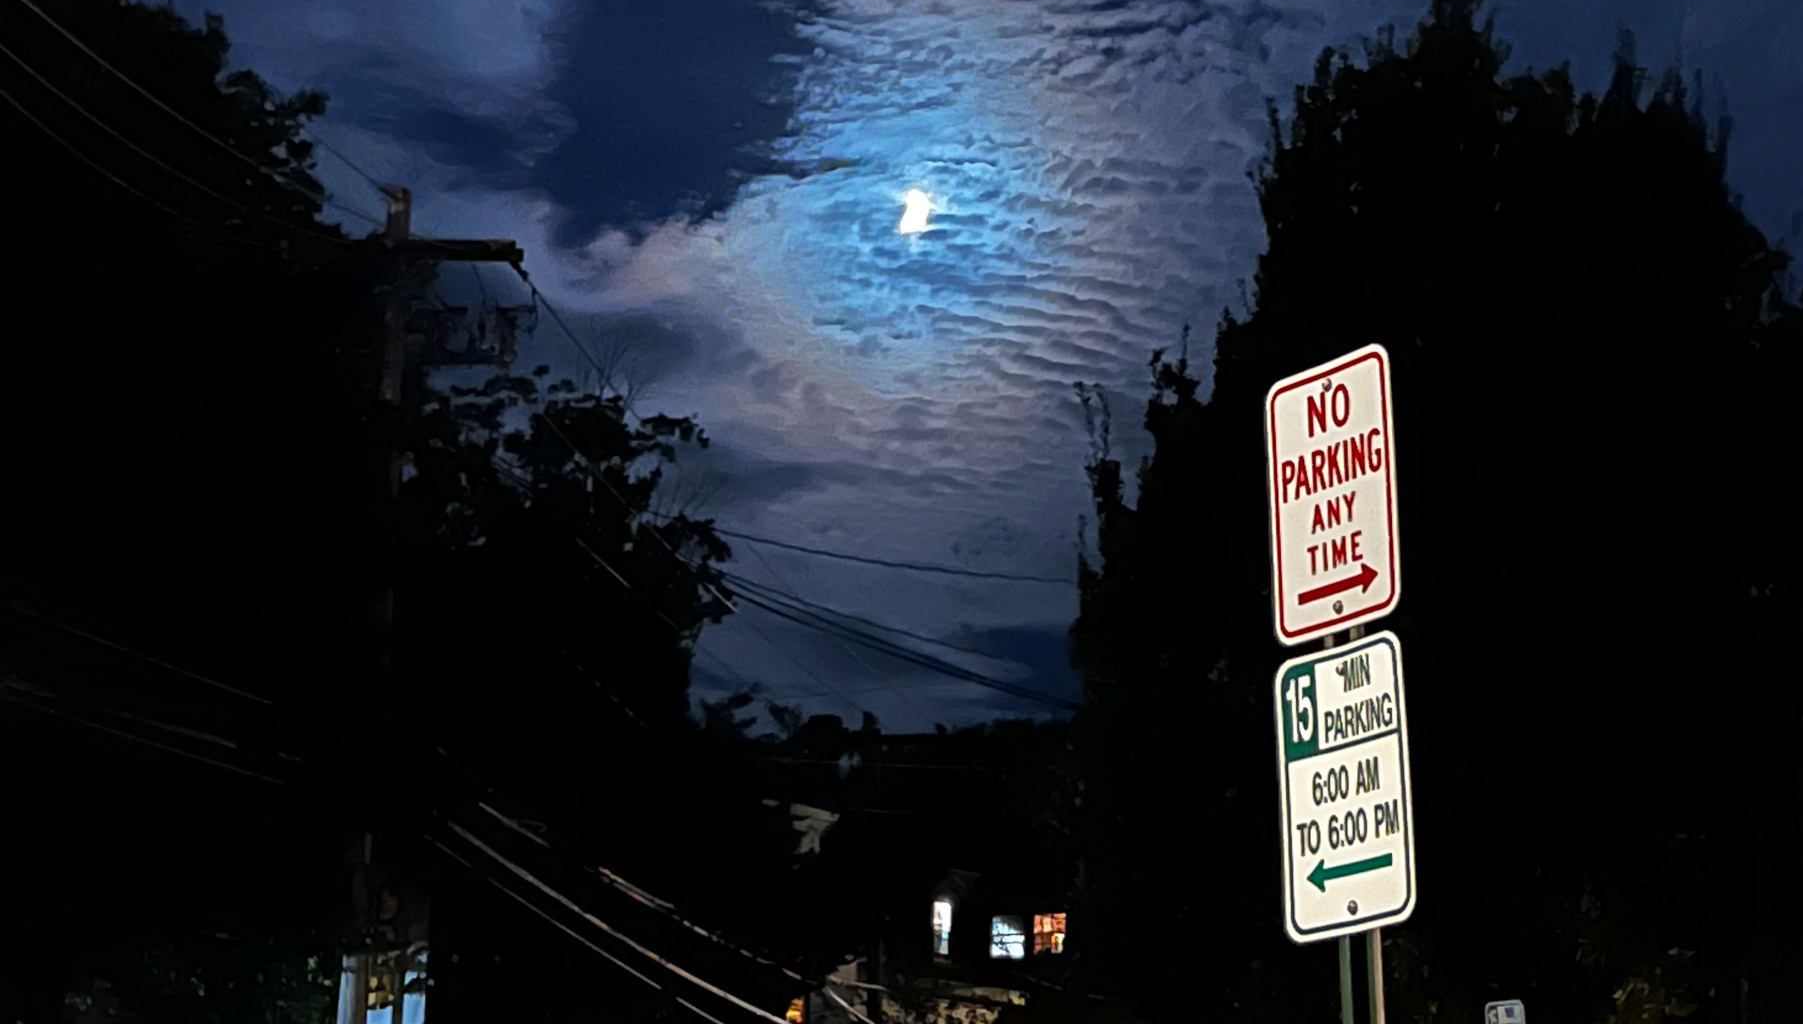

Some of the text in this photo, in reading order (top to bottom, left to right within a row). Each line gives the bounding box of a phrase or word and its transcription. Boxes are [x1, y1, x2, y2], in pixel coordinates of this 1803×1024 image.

[1307, 383, 1350, 438] NO
[1281, 428, 1382, 503] PARKING
[1311, 491, 1356, 535] ANY
[1307, 530, 1363, 576] TIME
[1343, 653, 1371, 693] MIN
[1286, 674, 1314, 743] 15
[1324, 692, 1393, 743] PARKING
[1312, 757, 1380, 806] 6:00 AM
[1296, 799, 1399, 857] TO 6:00 PM
